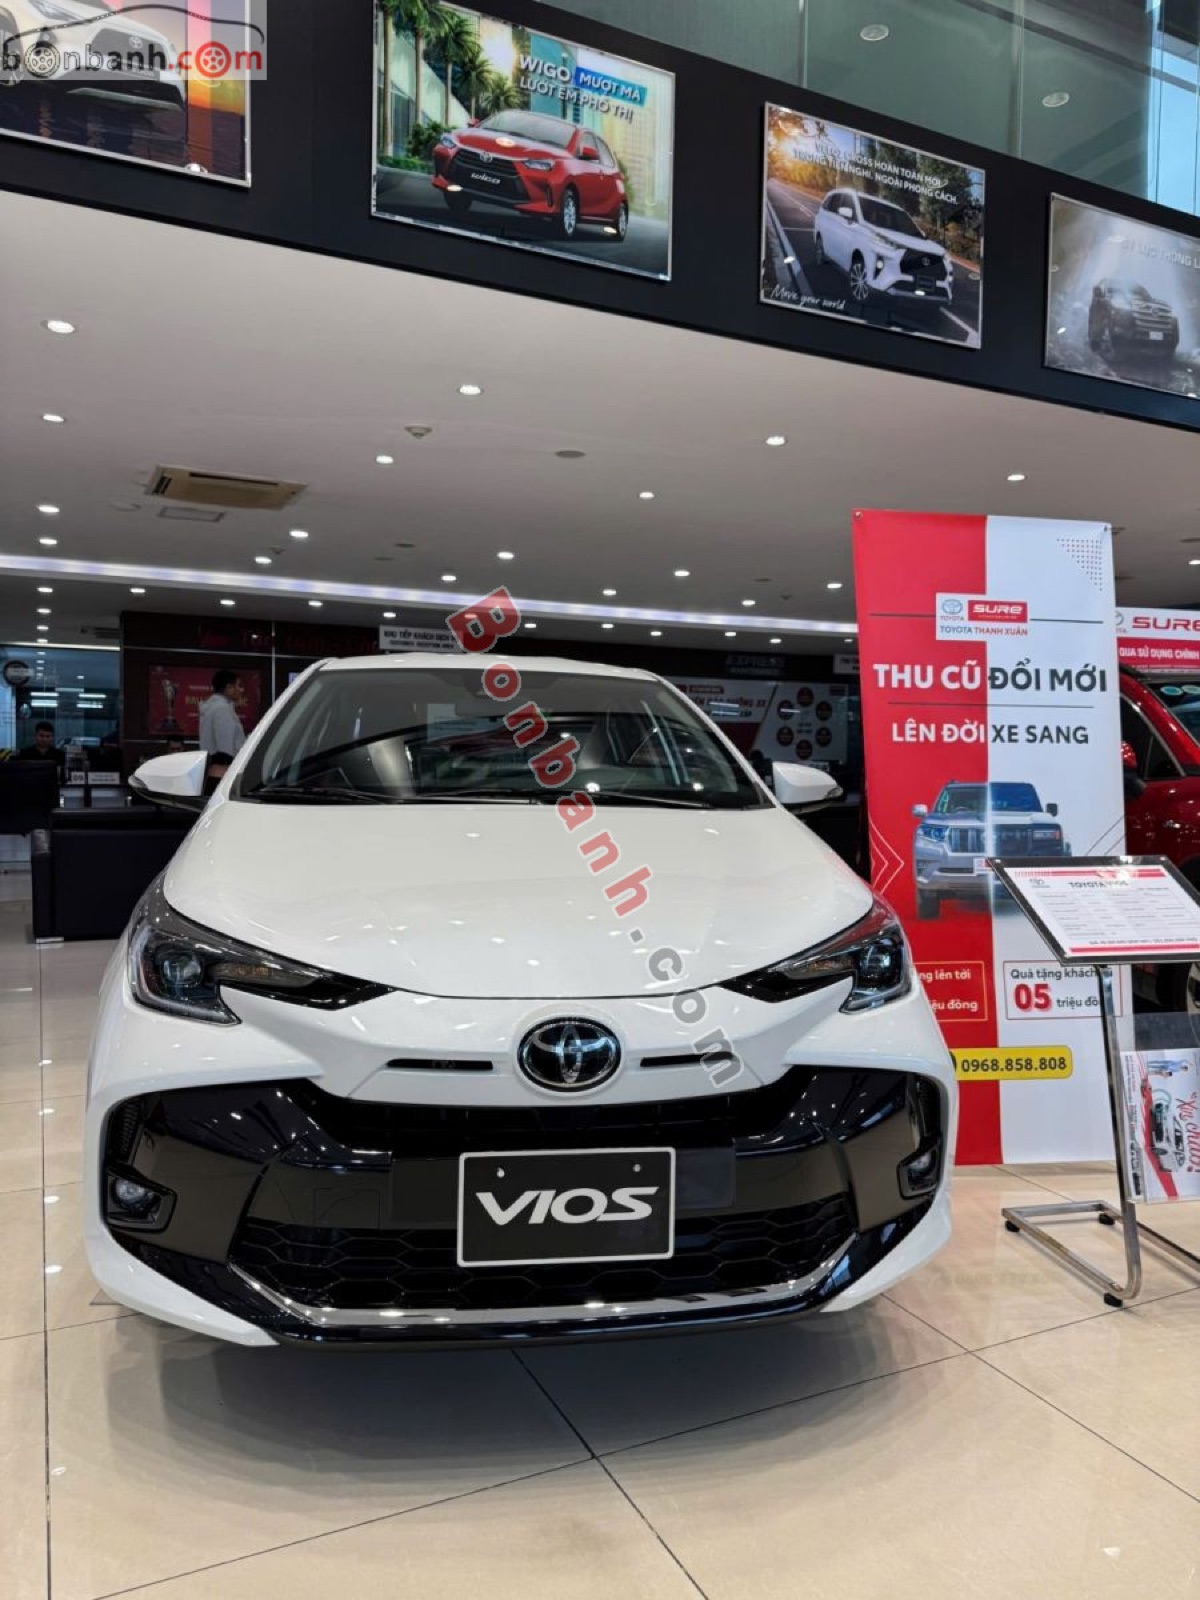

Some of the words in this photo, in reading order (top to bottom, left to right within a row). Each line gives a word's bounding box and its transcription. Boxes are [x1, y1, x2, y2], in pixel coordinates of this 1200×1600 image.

[519, 55, 571, 82] WIGO
[972, 604, 1023, 614] SURE
[940, 625, 973, 634] TOYOTA
[974, 626, 1004, 635] THANH
[1005, 626, 1028, 636] XUÂN
[873, 663, 933, 689] THU
[940, 660, 981, 690] CŨ
[988, 657, 1041, 691] ĐỔI
[1050, 663, 1108, 692] MỚI
[891, 717, 936, 743] LÊN
[941, 719, 985, 744] ĐỜI
[992, 724, 1019, 744] XE
[1025, 725, 1089, 745] SANG
[935, 968, 953, 980] lên
[954, 968, 972, 980] tới
[1010, 968, 1033, 980] Quà
[1036, 967, 1062, 981] tặng
[947, 999, 978, 1013] đồng
[1013, 983, 1051, 1012] 05
[1056, 997, 1082, 1010] triệu
[1084, 996, 1100, 1007] đồ
[961, 1056, 1067, 1073] 0968.858.808
[476, 1187, 659, 1226] VIOS
